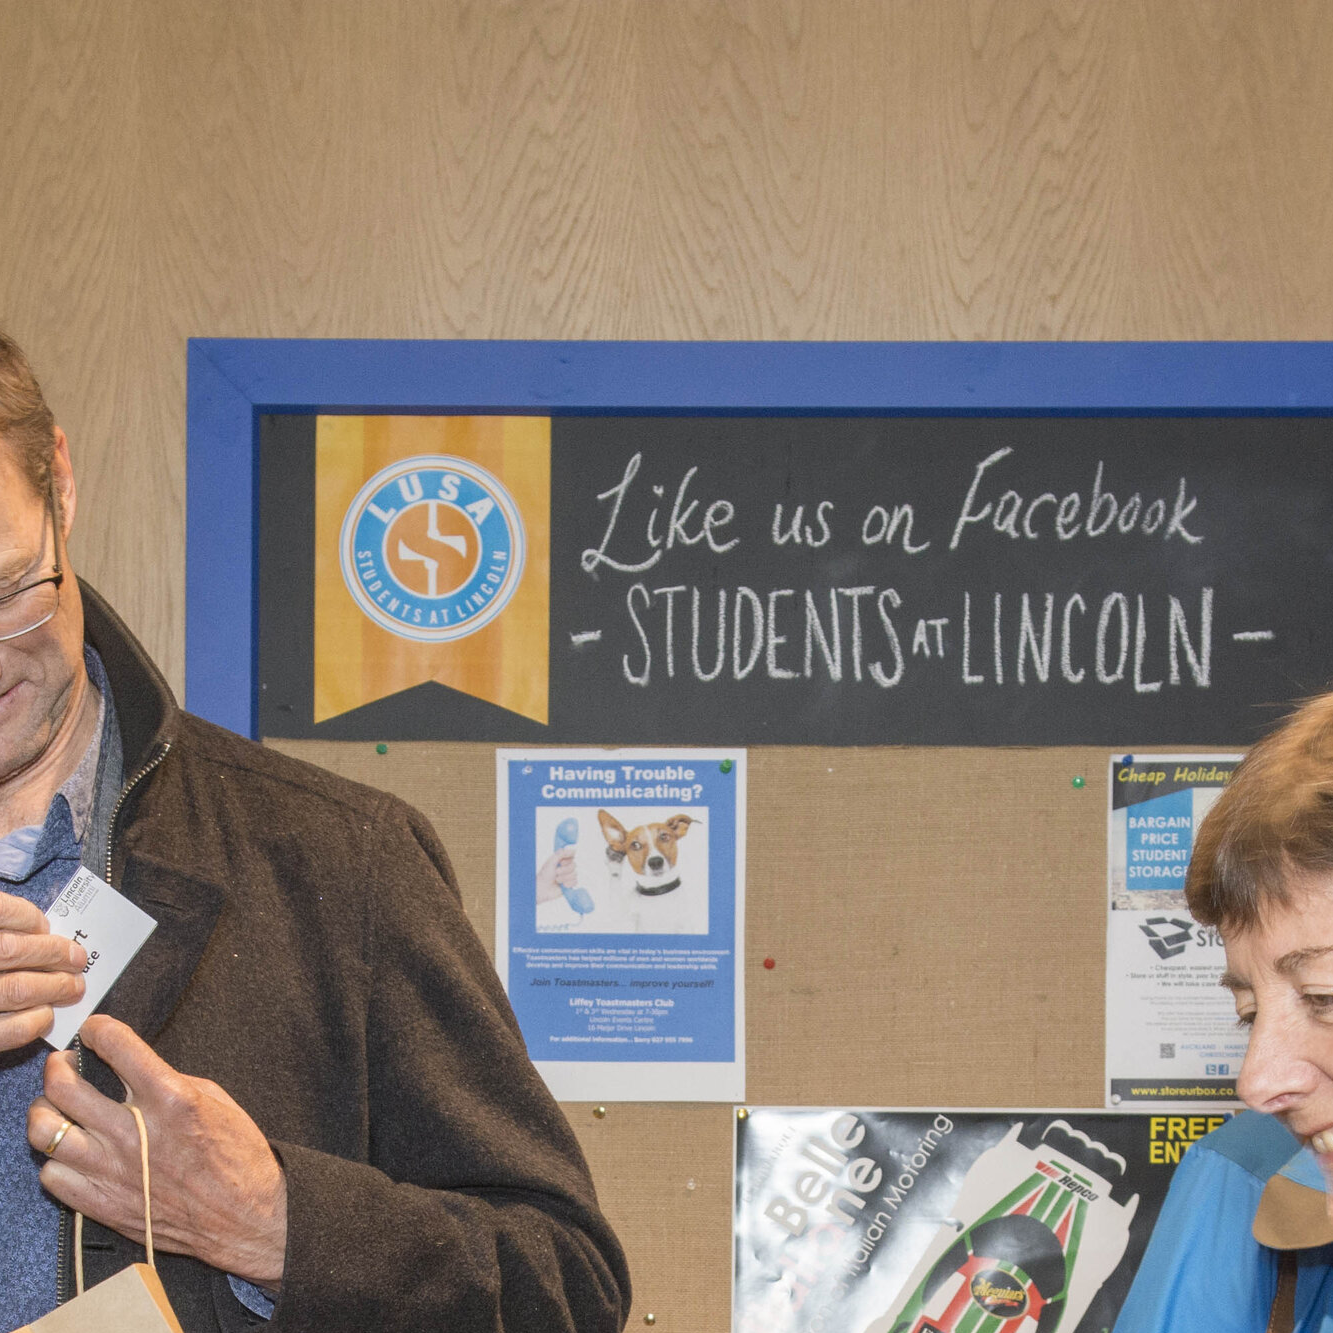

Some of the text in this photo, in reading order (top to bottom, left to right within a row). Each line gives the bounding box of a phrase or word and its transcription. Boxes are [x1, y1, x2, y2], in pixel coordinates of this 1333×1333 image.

[366, 473, 495, 526] LUSA
[580, 446, 1207, 574] Like us on Facebook
[357, 549, 507, 624] STUDENTS AT LINCOLN
[622, 583, 1215, 694] STUDENTS AT LINCOLN
[549, 765, 696, 784] Having Trouble
[1117, 767, 1166, 786] Cheap
[541, 784, 703, 802] Communicating?
[1128, 816, 1191, 829] BARGAIN
[1141, 833, 1179, 845] PRICE
[1132, 849, 1188, 862] STUDENT
[60, 876, 83, 904] Lincoln
[67, 873, 95, 908] University
[595, 998, 653, 1007] Toastmasters
[655, 999, 675, 1007] Club
[1131, 1086, 1237, 1096] www.storeurbox.co.
[763, 1113, 866, 1237] Belle
[883, 1114, 954, 1211] Motoring
[1056, 1174, 1099, 1203] Repco
